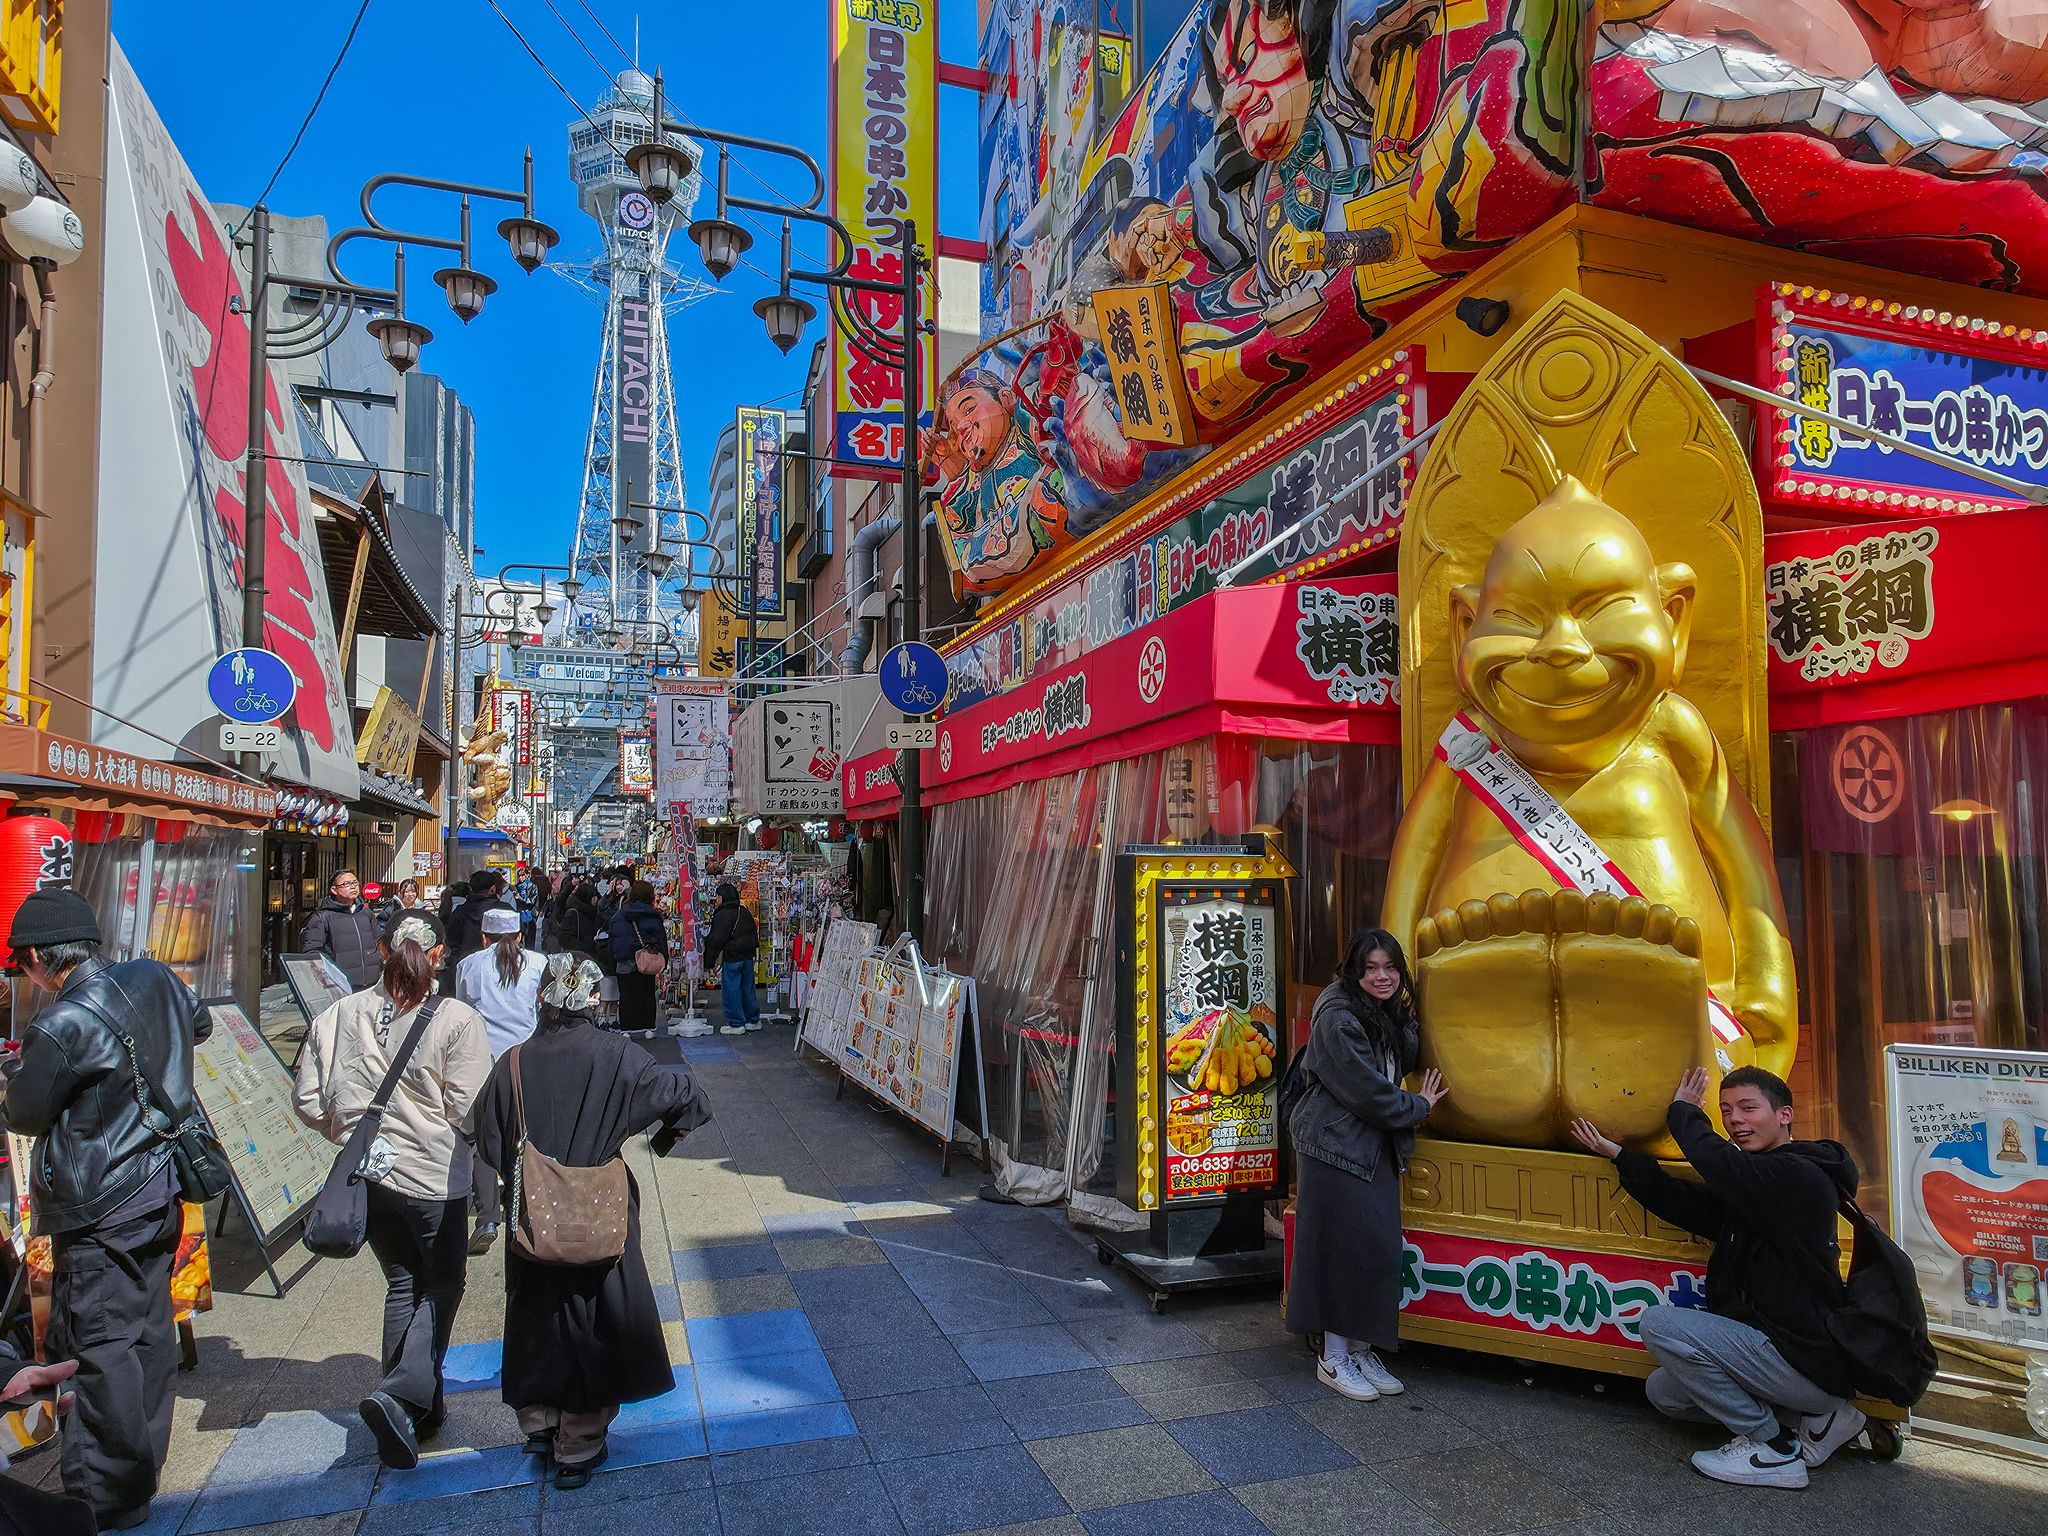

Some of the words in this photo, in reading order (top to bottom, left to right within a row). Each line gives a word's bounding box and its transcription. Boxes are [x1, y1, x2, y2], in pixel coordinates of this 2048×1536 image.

[850, 0, 921, 31] 新世界
[865, 27, 908, 246] 日本一の串かつ
[614, 227, 652, 242] HITACH
[622, 302, 649, 443] HITACHI
[1798, 344, 1831, 459] 新世界
[1169, 507, 1269, 596] 日本一の串かつ
[1770, 531, 1934, 589] 日本一の串かつ
[1157, 538, 1170, 614] 新世界
[1770, 559, 1928, 656] 横綱
[565, 666, 606, 681] Welcome
[1804, 647, 1870, 678] よこづな
[1044, 673, 1086, 737] 横綱
[982, 707, 1042, 753] 日本一の串かつ
[93, 752, 138, 788] 大衆酒場
[766, 787, 776, 796] 1F
[780, 787, 840, 797] カウンター席
[1519, 772, 1552, 803] DIVERSITY
[766, 800, 776, 809] 2F
[1179, 938, 1194, 1000] よこづな
[1192, 911, 1250, 1010] 横綱
[1251, 917, 1264, 1002] 日本一の串かつ
[1898, 1057, 1990, 1076] BILLIKEN
[1907, 1103, 1946, 1113] スマホで
[1909, 1112, 1980, 1123] ビリケンさんに
[1911, 1122, 1972, 1134] 今日の気分を
[1972, 1238, 2026, 1252] EMOTIONS
[1976, 1231, 2021, 1243] BILLIKEN
